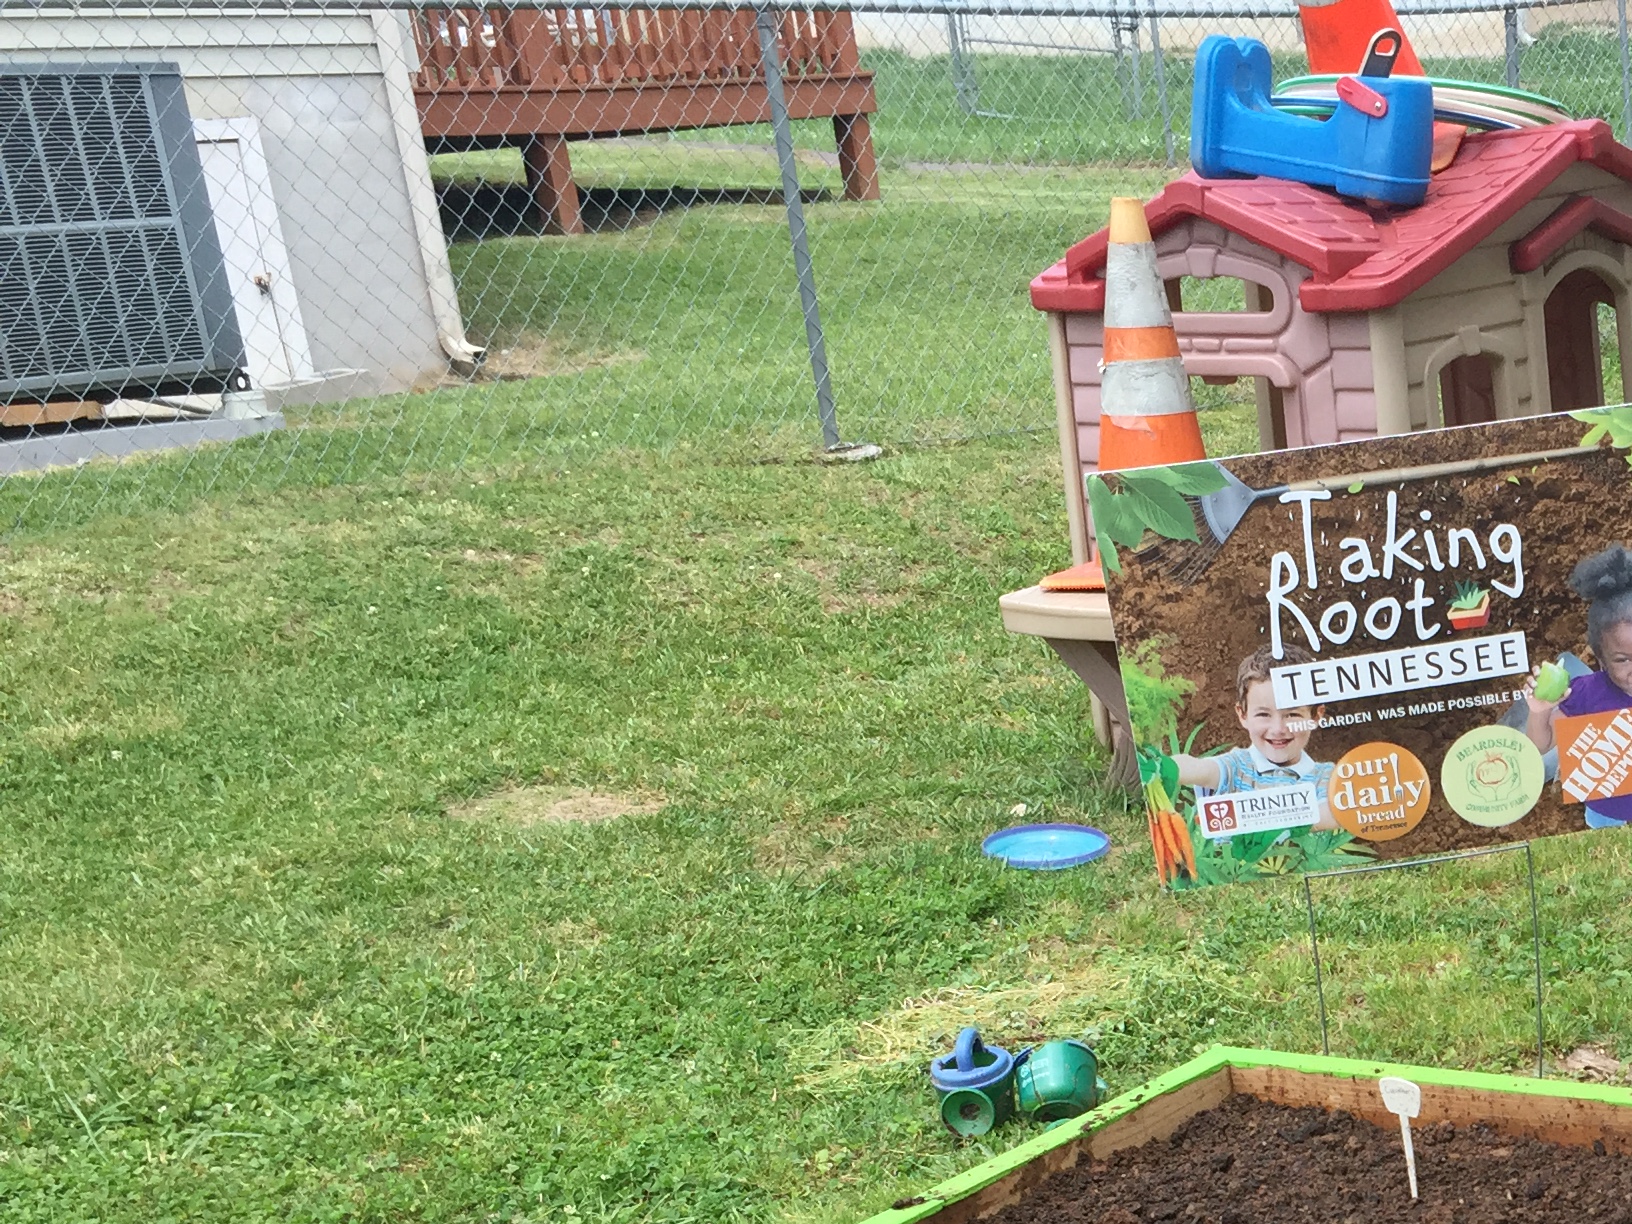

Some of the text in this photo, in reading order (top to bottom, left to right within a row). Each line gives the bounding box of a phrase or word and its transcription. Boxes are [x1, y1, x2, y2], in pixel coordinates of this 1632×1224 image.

[1279, 490, 1524, 598] Taking
[1266, 551, 1442, 660] Root
[1281, 639, 1519, 701] TENNESSEE
[1286, 718, 1317, 733] THIS
[1318, 711, 1372, 729] GARDEN
[1377, 706, 1406, 720] WAS
[1409, 702, 1446, 716] MADE
[1448, 693, 1511, 711] POSSIBLE
[1456, 738, 1525, 762] BEARDSLEY
[1566, 723, 1602, 760] THE
[1337, 757, 1389, 779] our
[1236, 790, 1310, 813] TRINITY
[1356, 804, 1406, 824] bread
